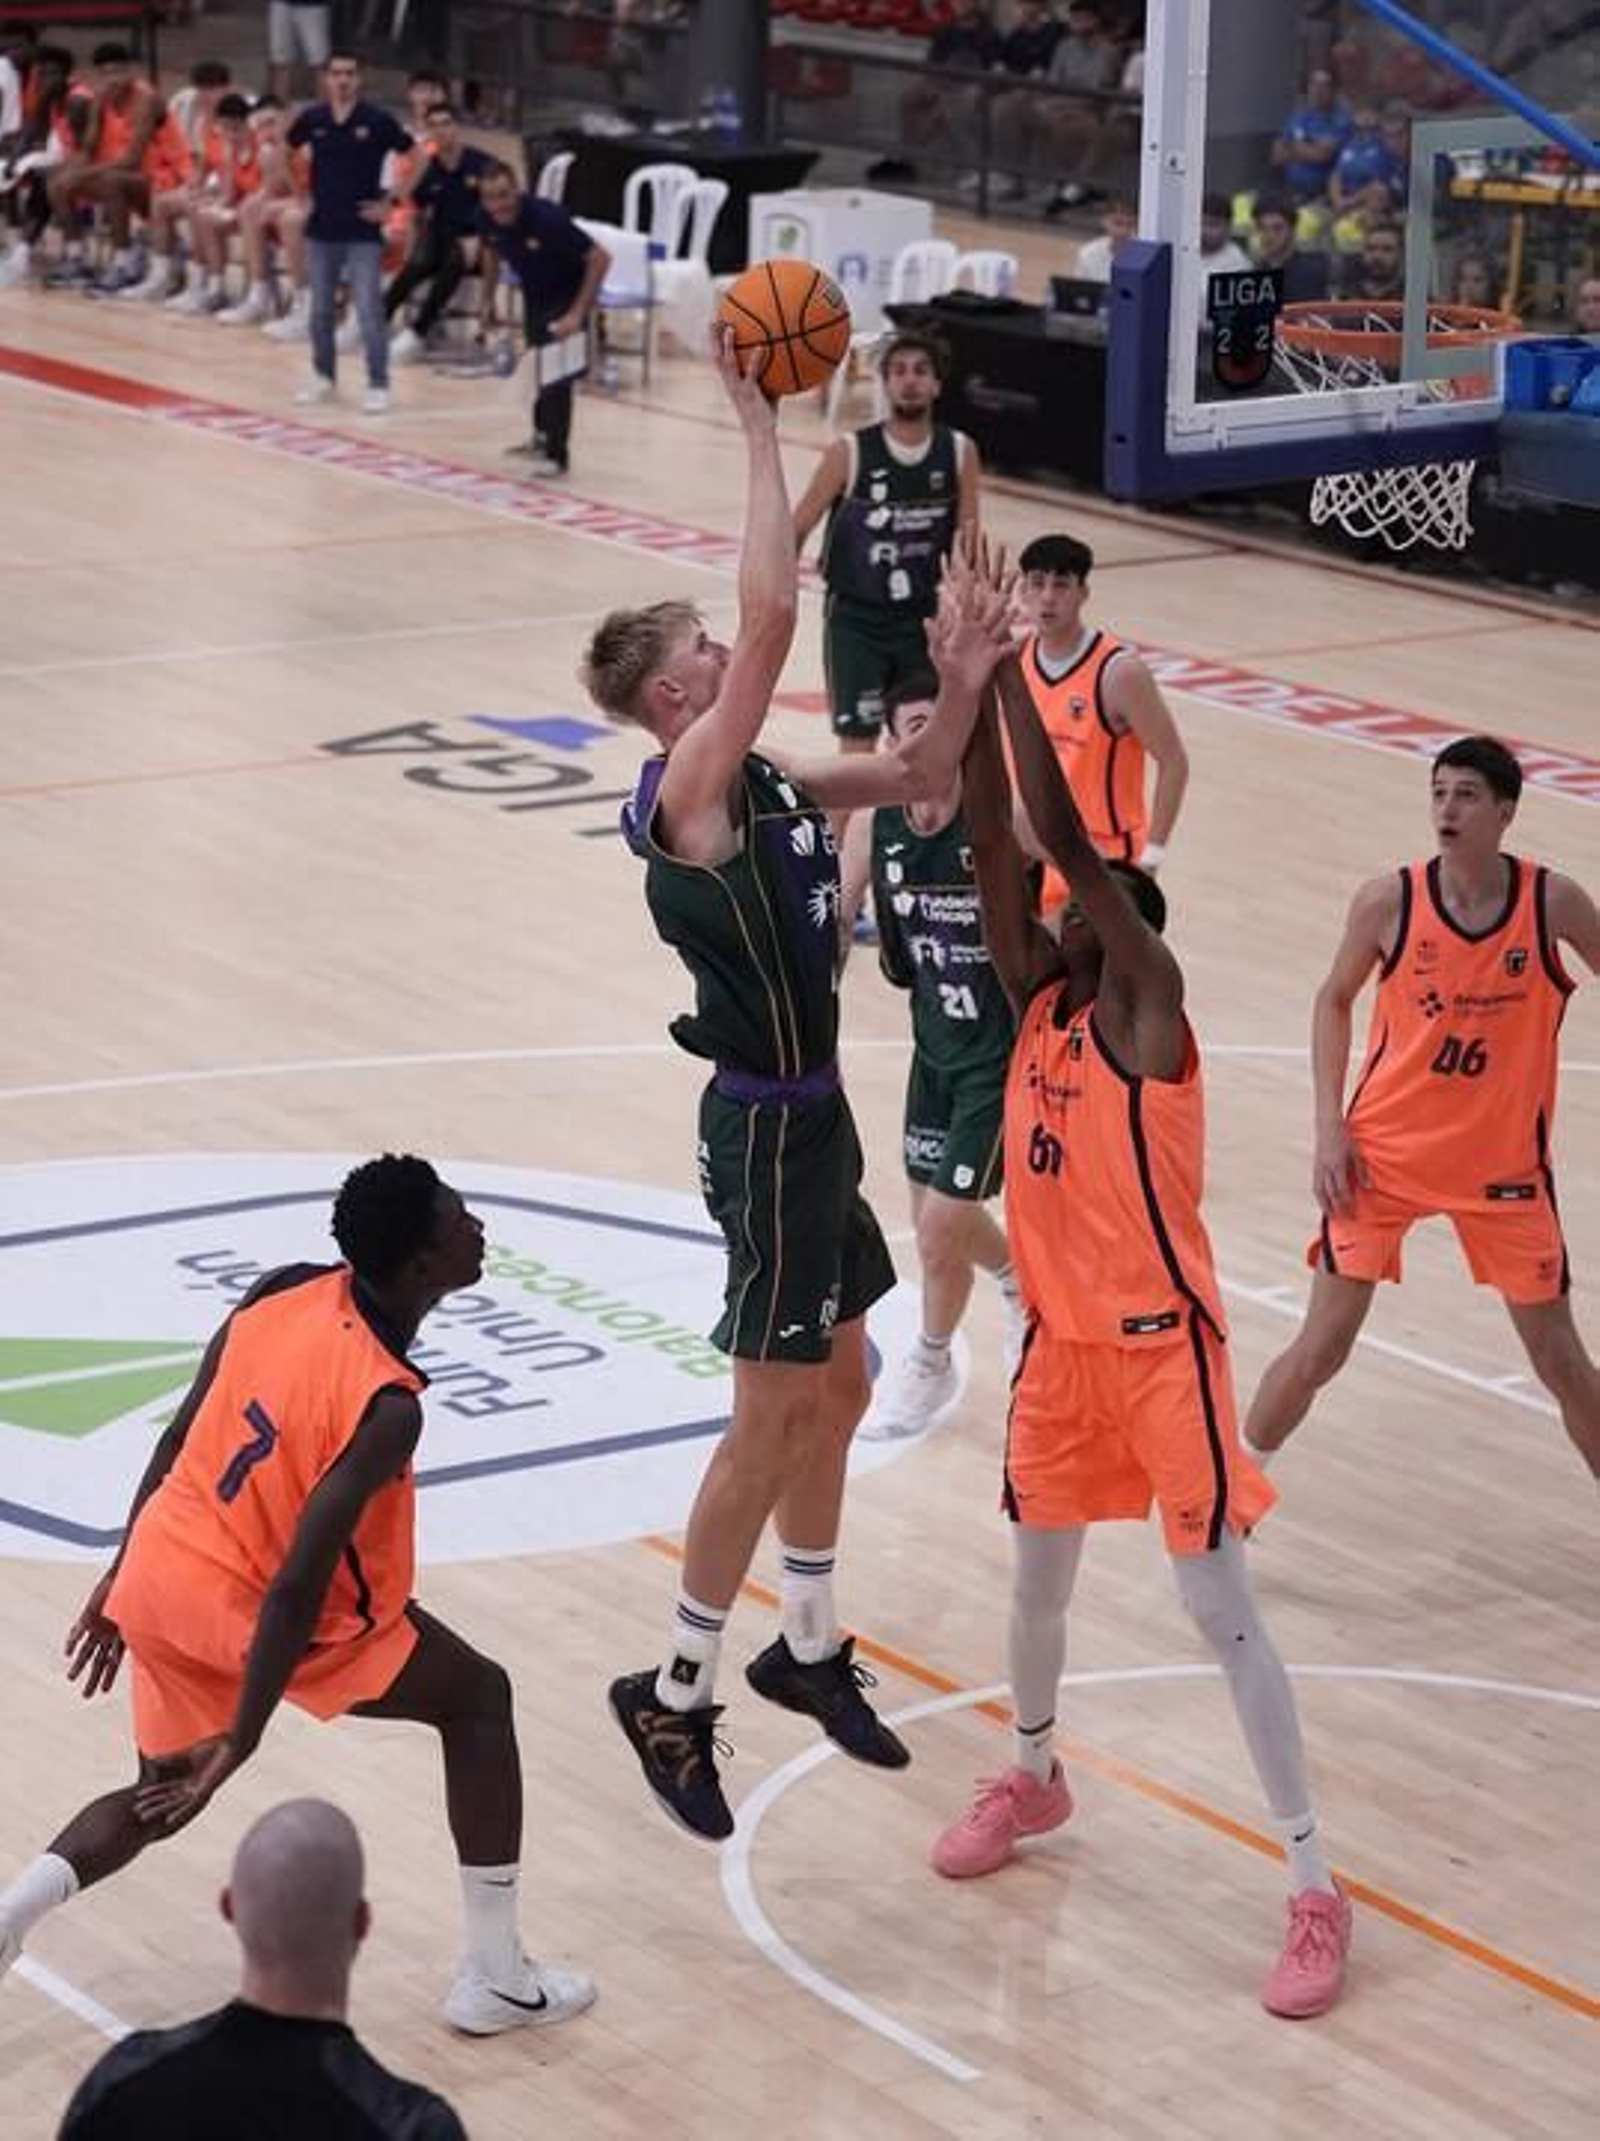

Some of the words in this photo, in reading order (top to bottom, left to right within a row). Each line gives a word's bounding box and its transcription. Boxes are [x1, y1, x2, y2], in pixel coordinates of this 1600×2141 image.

[1213, 276, 1277, 306] LIGA
[938, 983, 979, 1020] 21
[216, 1399, 277, 1503] 7
